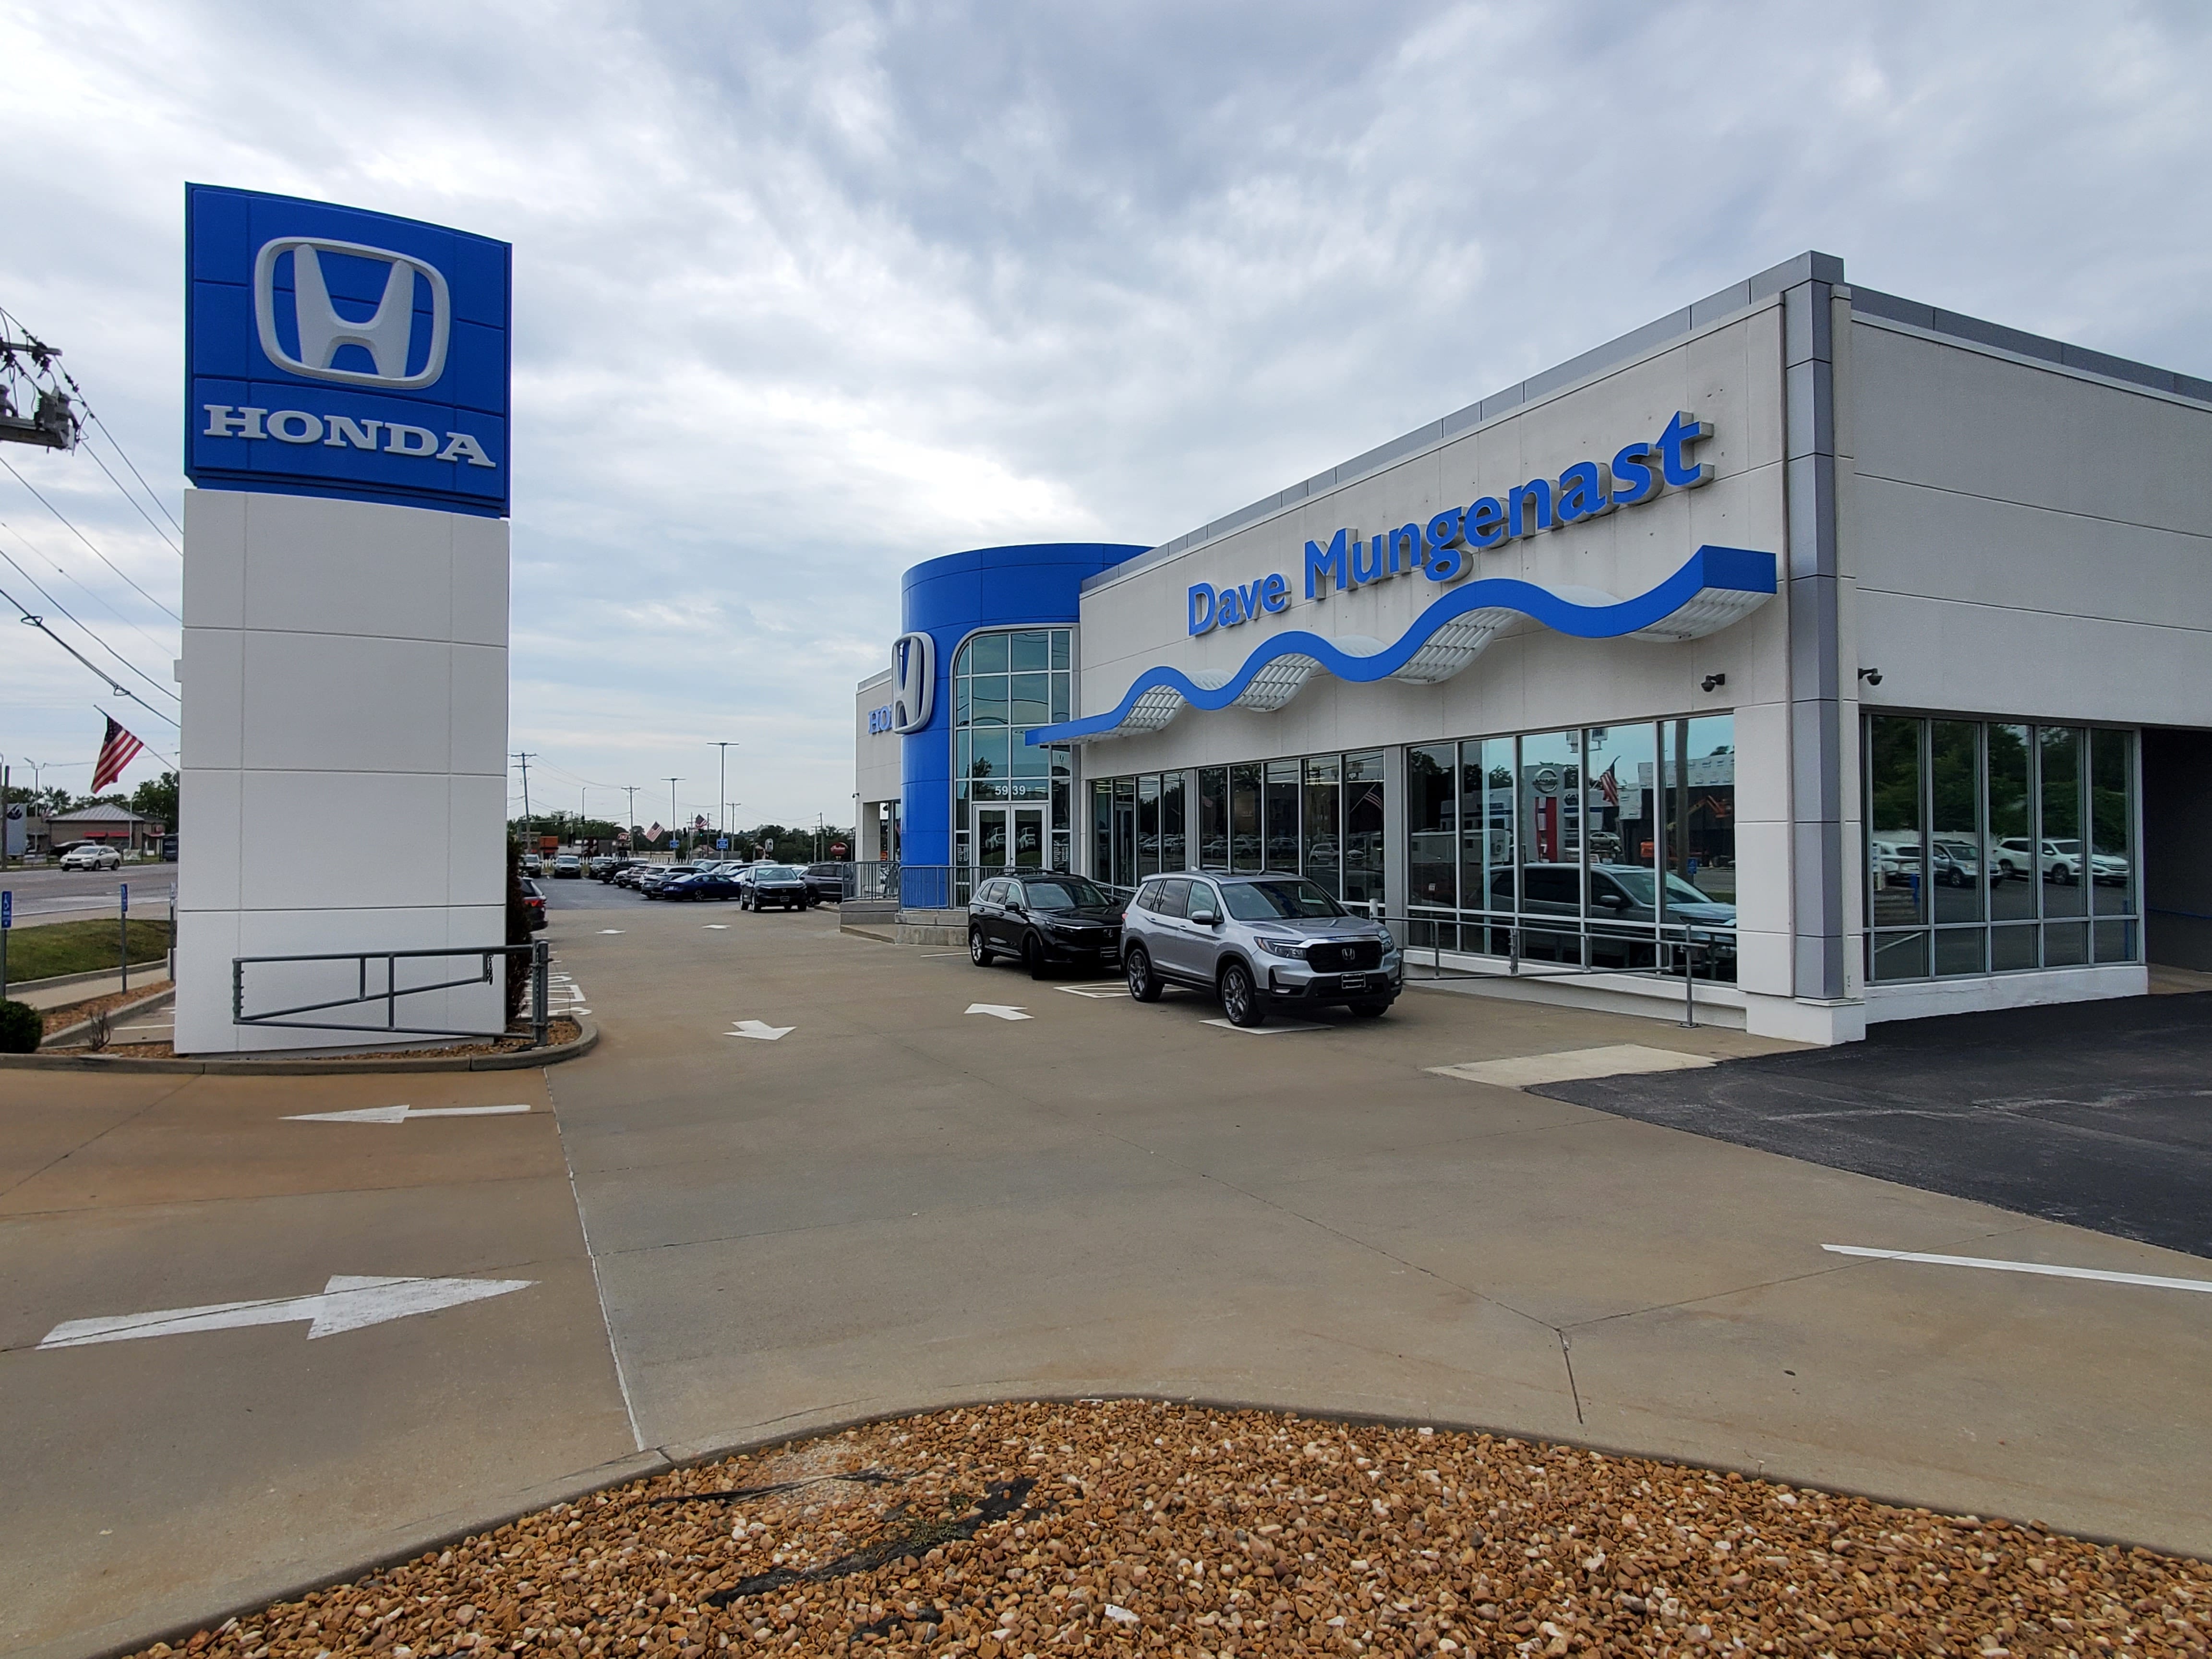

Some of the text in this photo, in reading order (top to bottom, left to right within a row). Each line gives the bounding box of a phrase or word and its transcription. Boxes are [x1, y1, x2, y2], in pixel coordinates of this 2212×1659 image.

[204, 405, 496, 468] HONDA
[1188, 410, 1713, 637] Dave Mungenast
[868, 704, 892, 733] HO
[995, 785, 1026, 795] 5939
